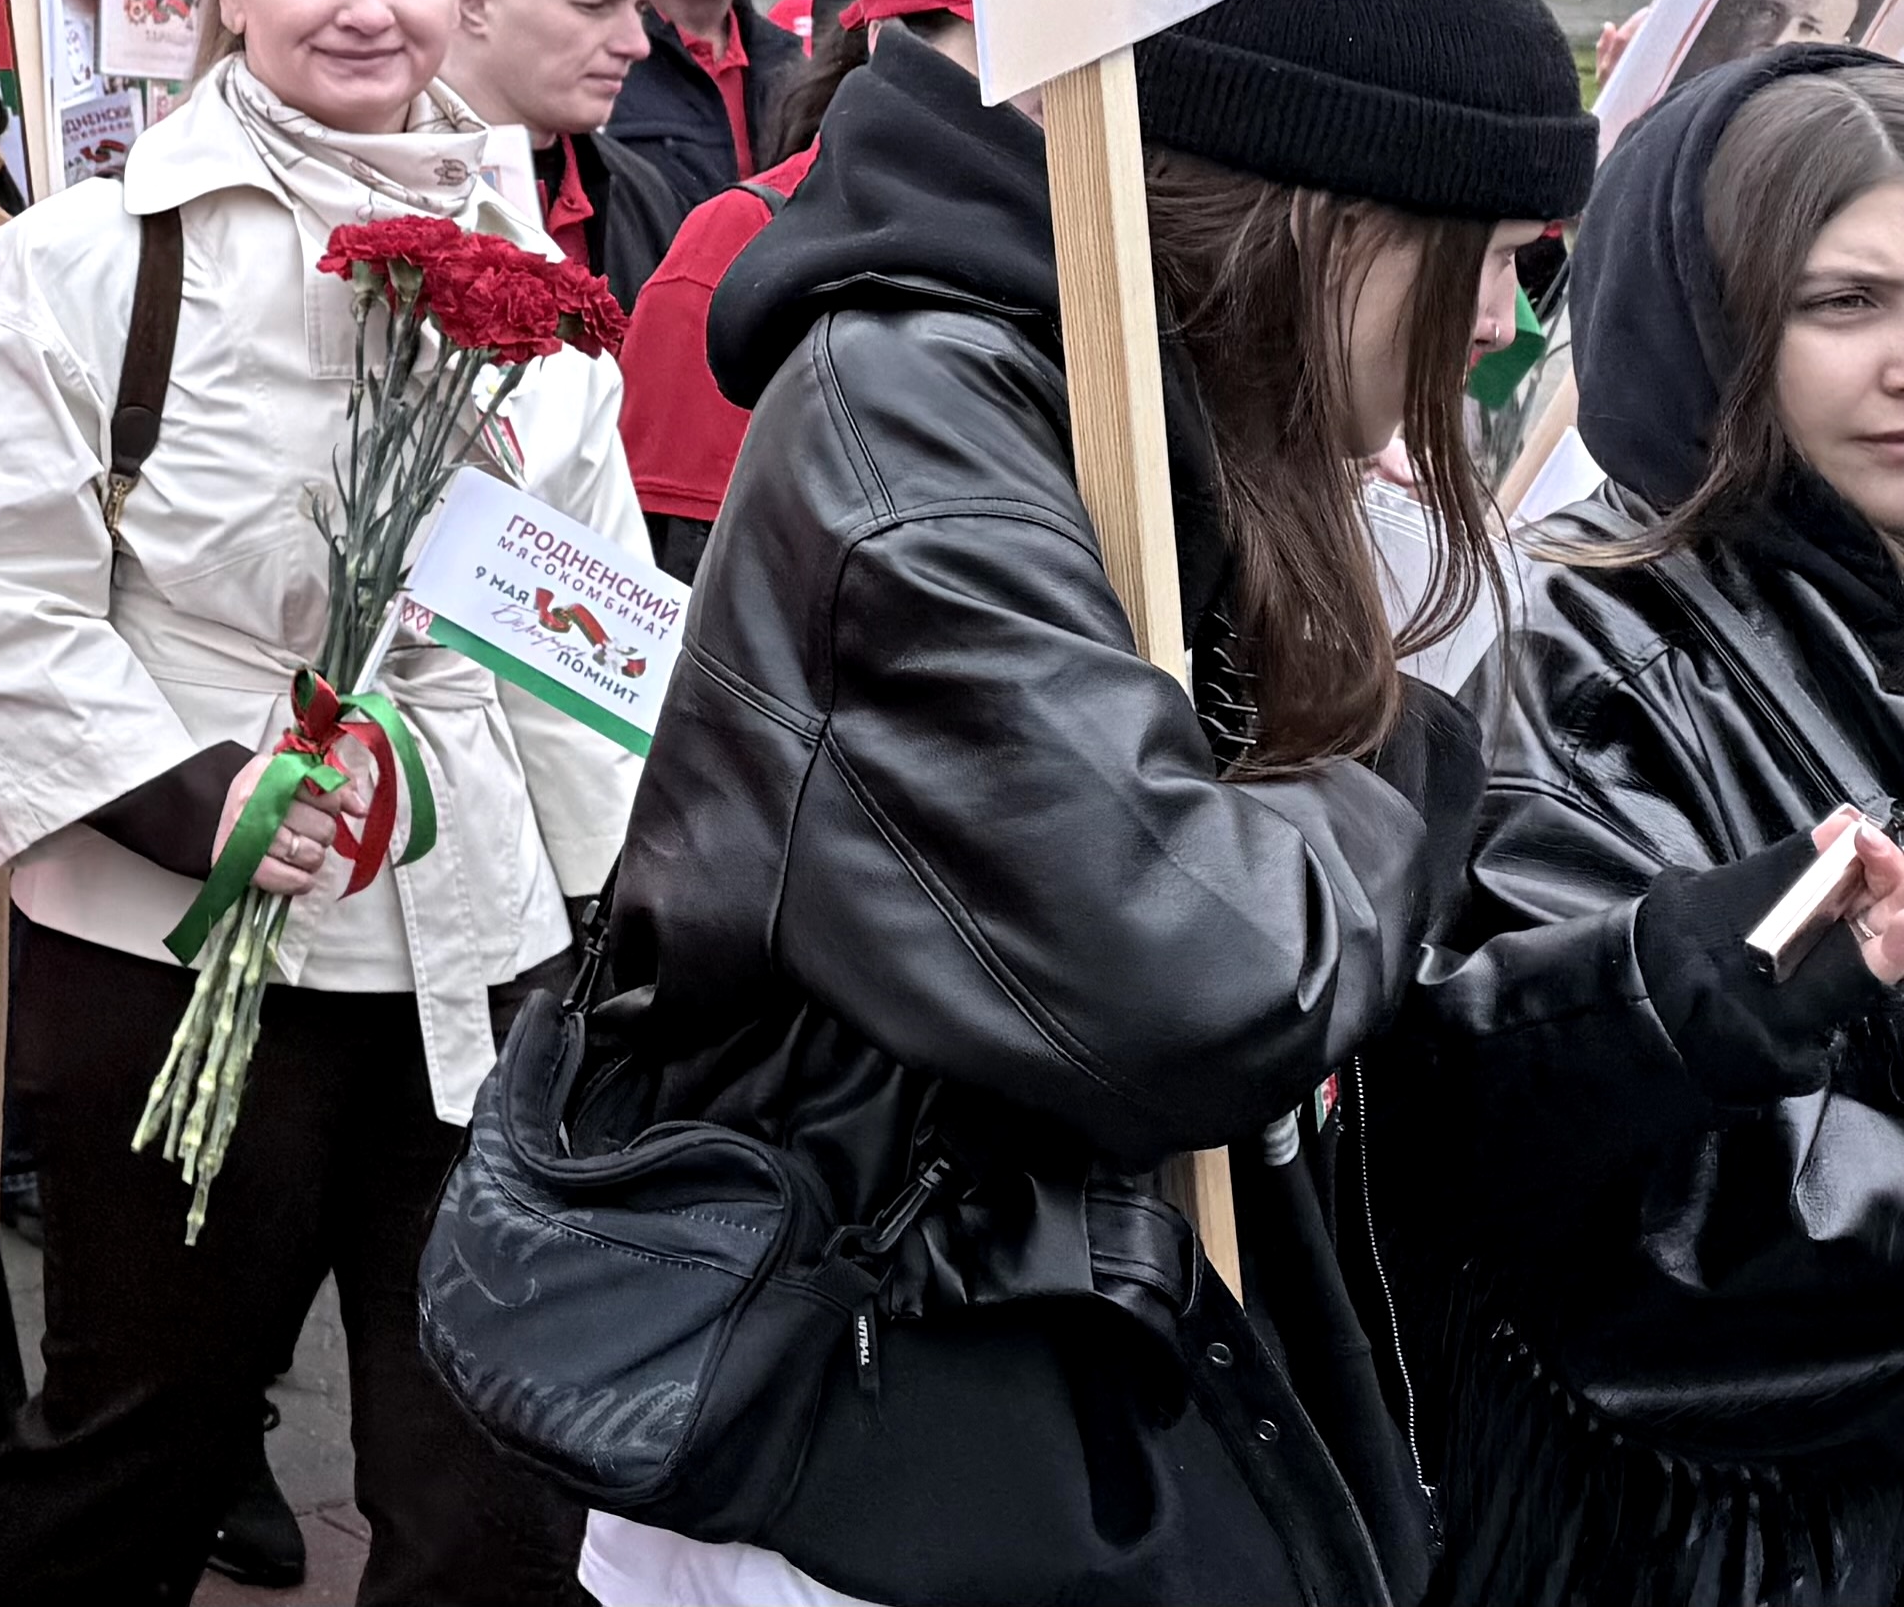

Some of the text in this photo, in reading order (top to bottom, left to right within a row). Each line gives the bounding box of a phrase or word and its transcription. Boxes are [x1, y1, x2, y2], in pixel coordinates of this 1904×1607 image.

[475, 565, 530, 605] 9 МАЯ
[496, 535, 669, 641] МЯСОКОМБИНАТ
[505, 514, 682, 627] ГРОДНЕНСКИЙ
[556, 650, 641, 705] ПОМНИТ
